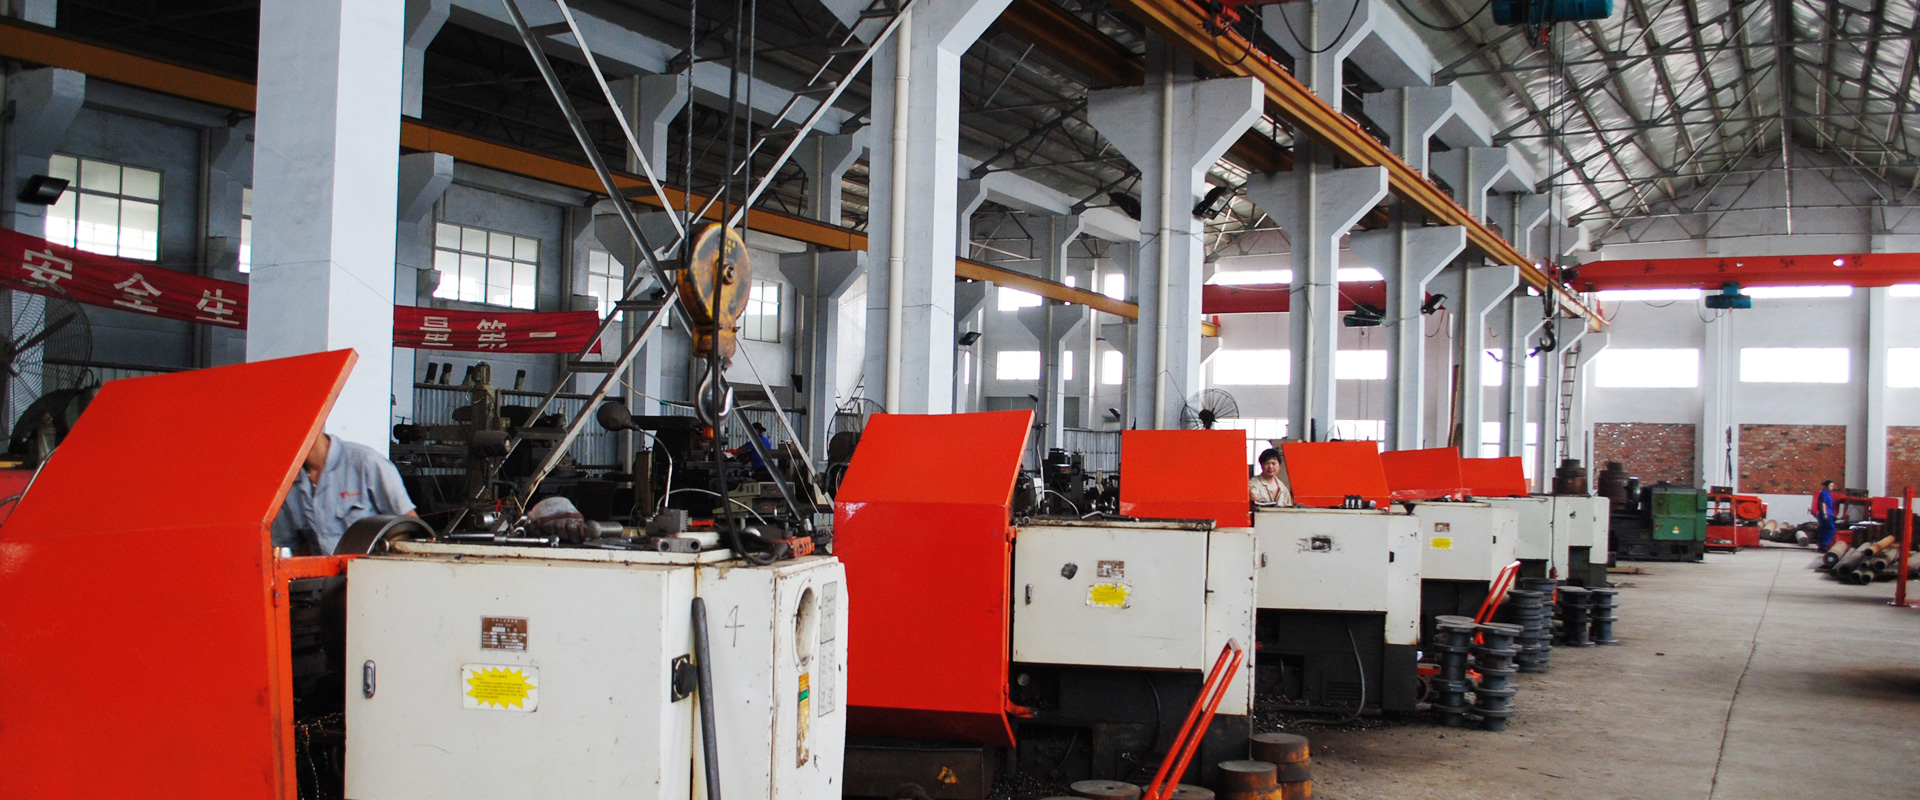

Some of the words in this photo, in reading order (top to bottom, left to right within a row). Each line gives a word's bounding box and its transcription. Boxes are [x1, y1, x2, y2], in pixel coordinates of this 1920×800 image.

[22, 249, 240, 325] 安全生
[419, 316, 558, 349] 量第一
[724, 604, 745, 648] 4
